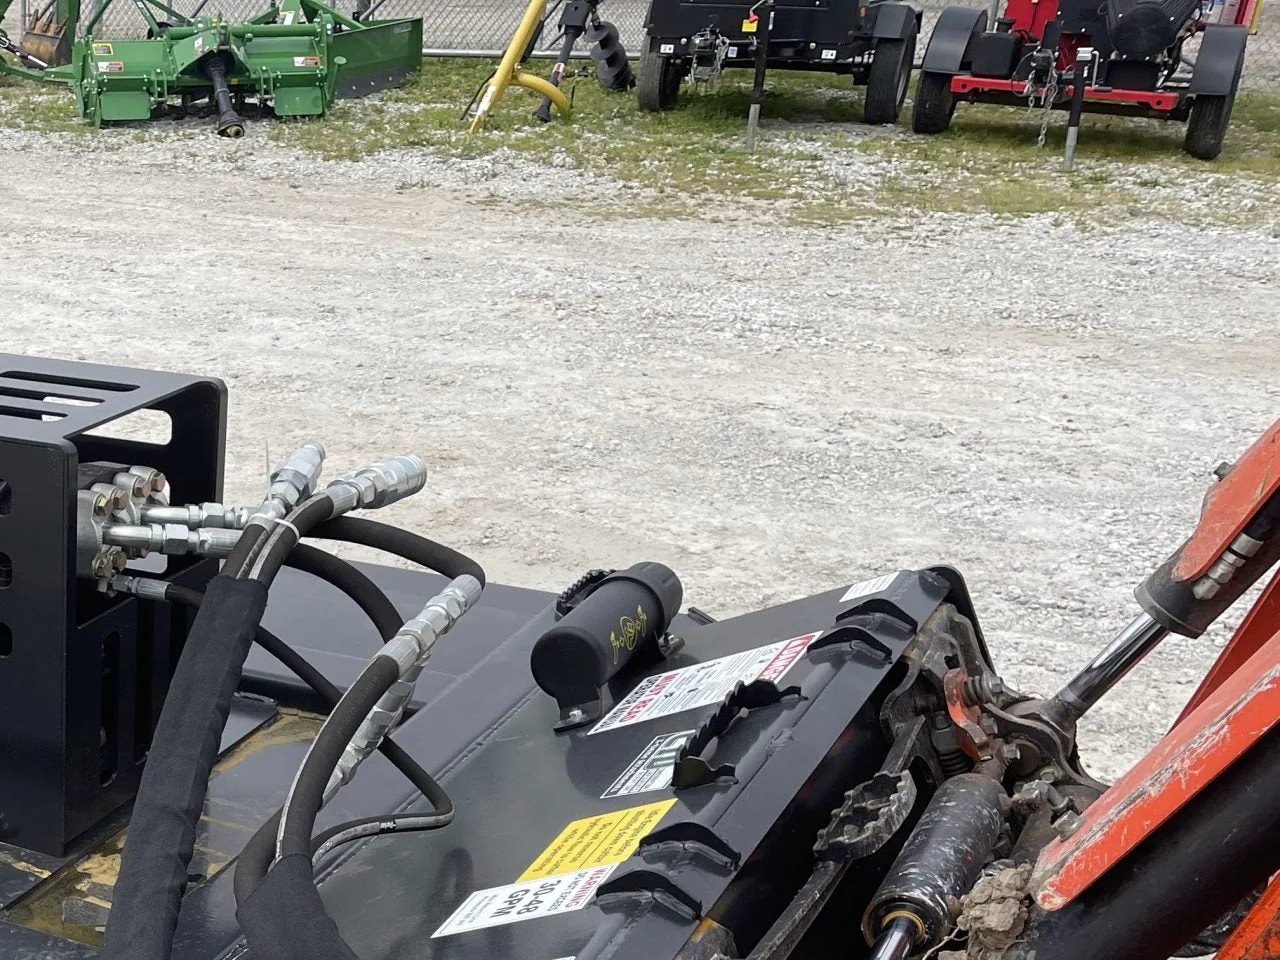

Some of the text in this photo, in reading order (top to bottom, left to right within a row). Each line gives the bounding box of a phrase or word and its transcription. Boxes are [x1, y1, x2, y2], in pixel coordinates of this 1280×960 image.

[757, 644, 804, 681] DANGE
[513, 878, 564, 916] 30-48
[544, 889, 573, 912] EXCEED
[562, 866, 609, 909] WARNING
[563, 879, 582, 891] NOT
[487, 887, 533, 919] GPM
